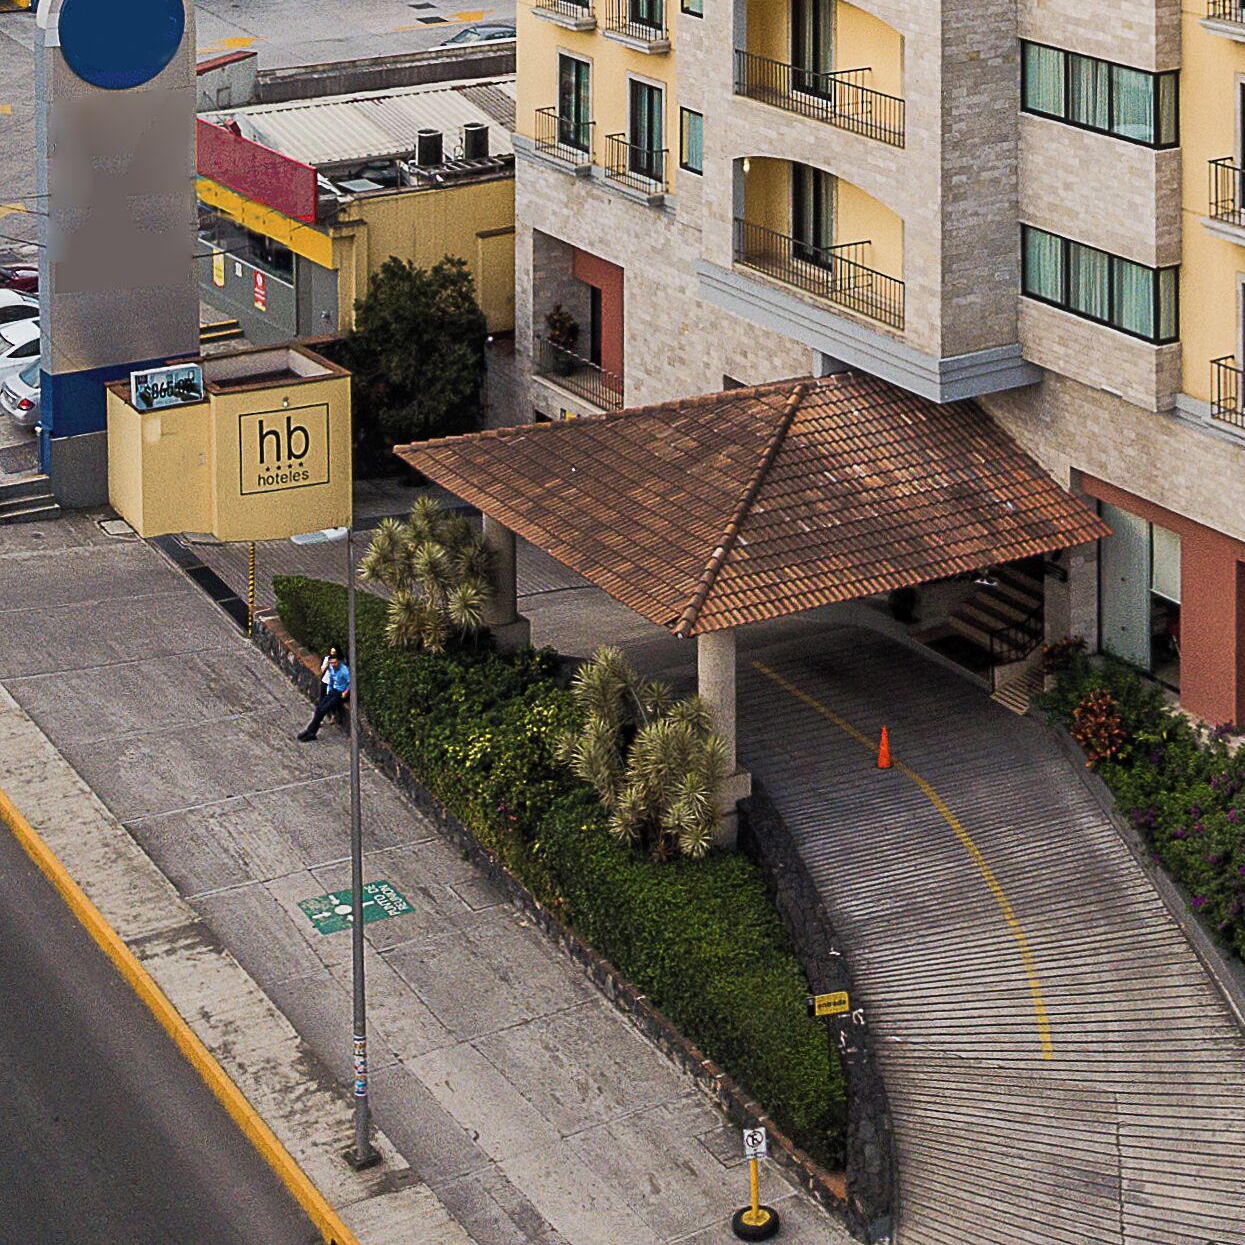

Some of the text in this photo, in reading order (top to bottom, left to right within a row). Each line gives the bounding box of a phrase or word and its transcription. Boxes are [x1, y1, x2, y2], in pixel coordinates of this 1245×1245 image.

[258, 416, 310, 464] hb
[257, 470, 309, 486] hoteles
[373, 893, 402, 916] PUNTO
